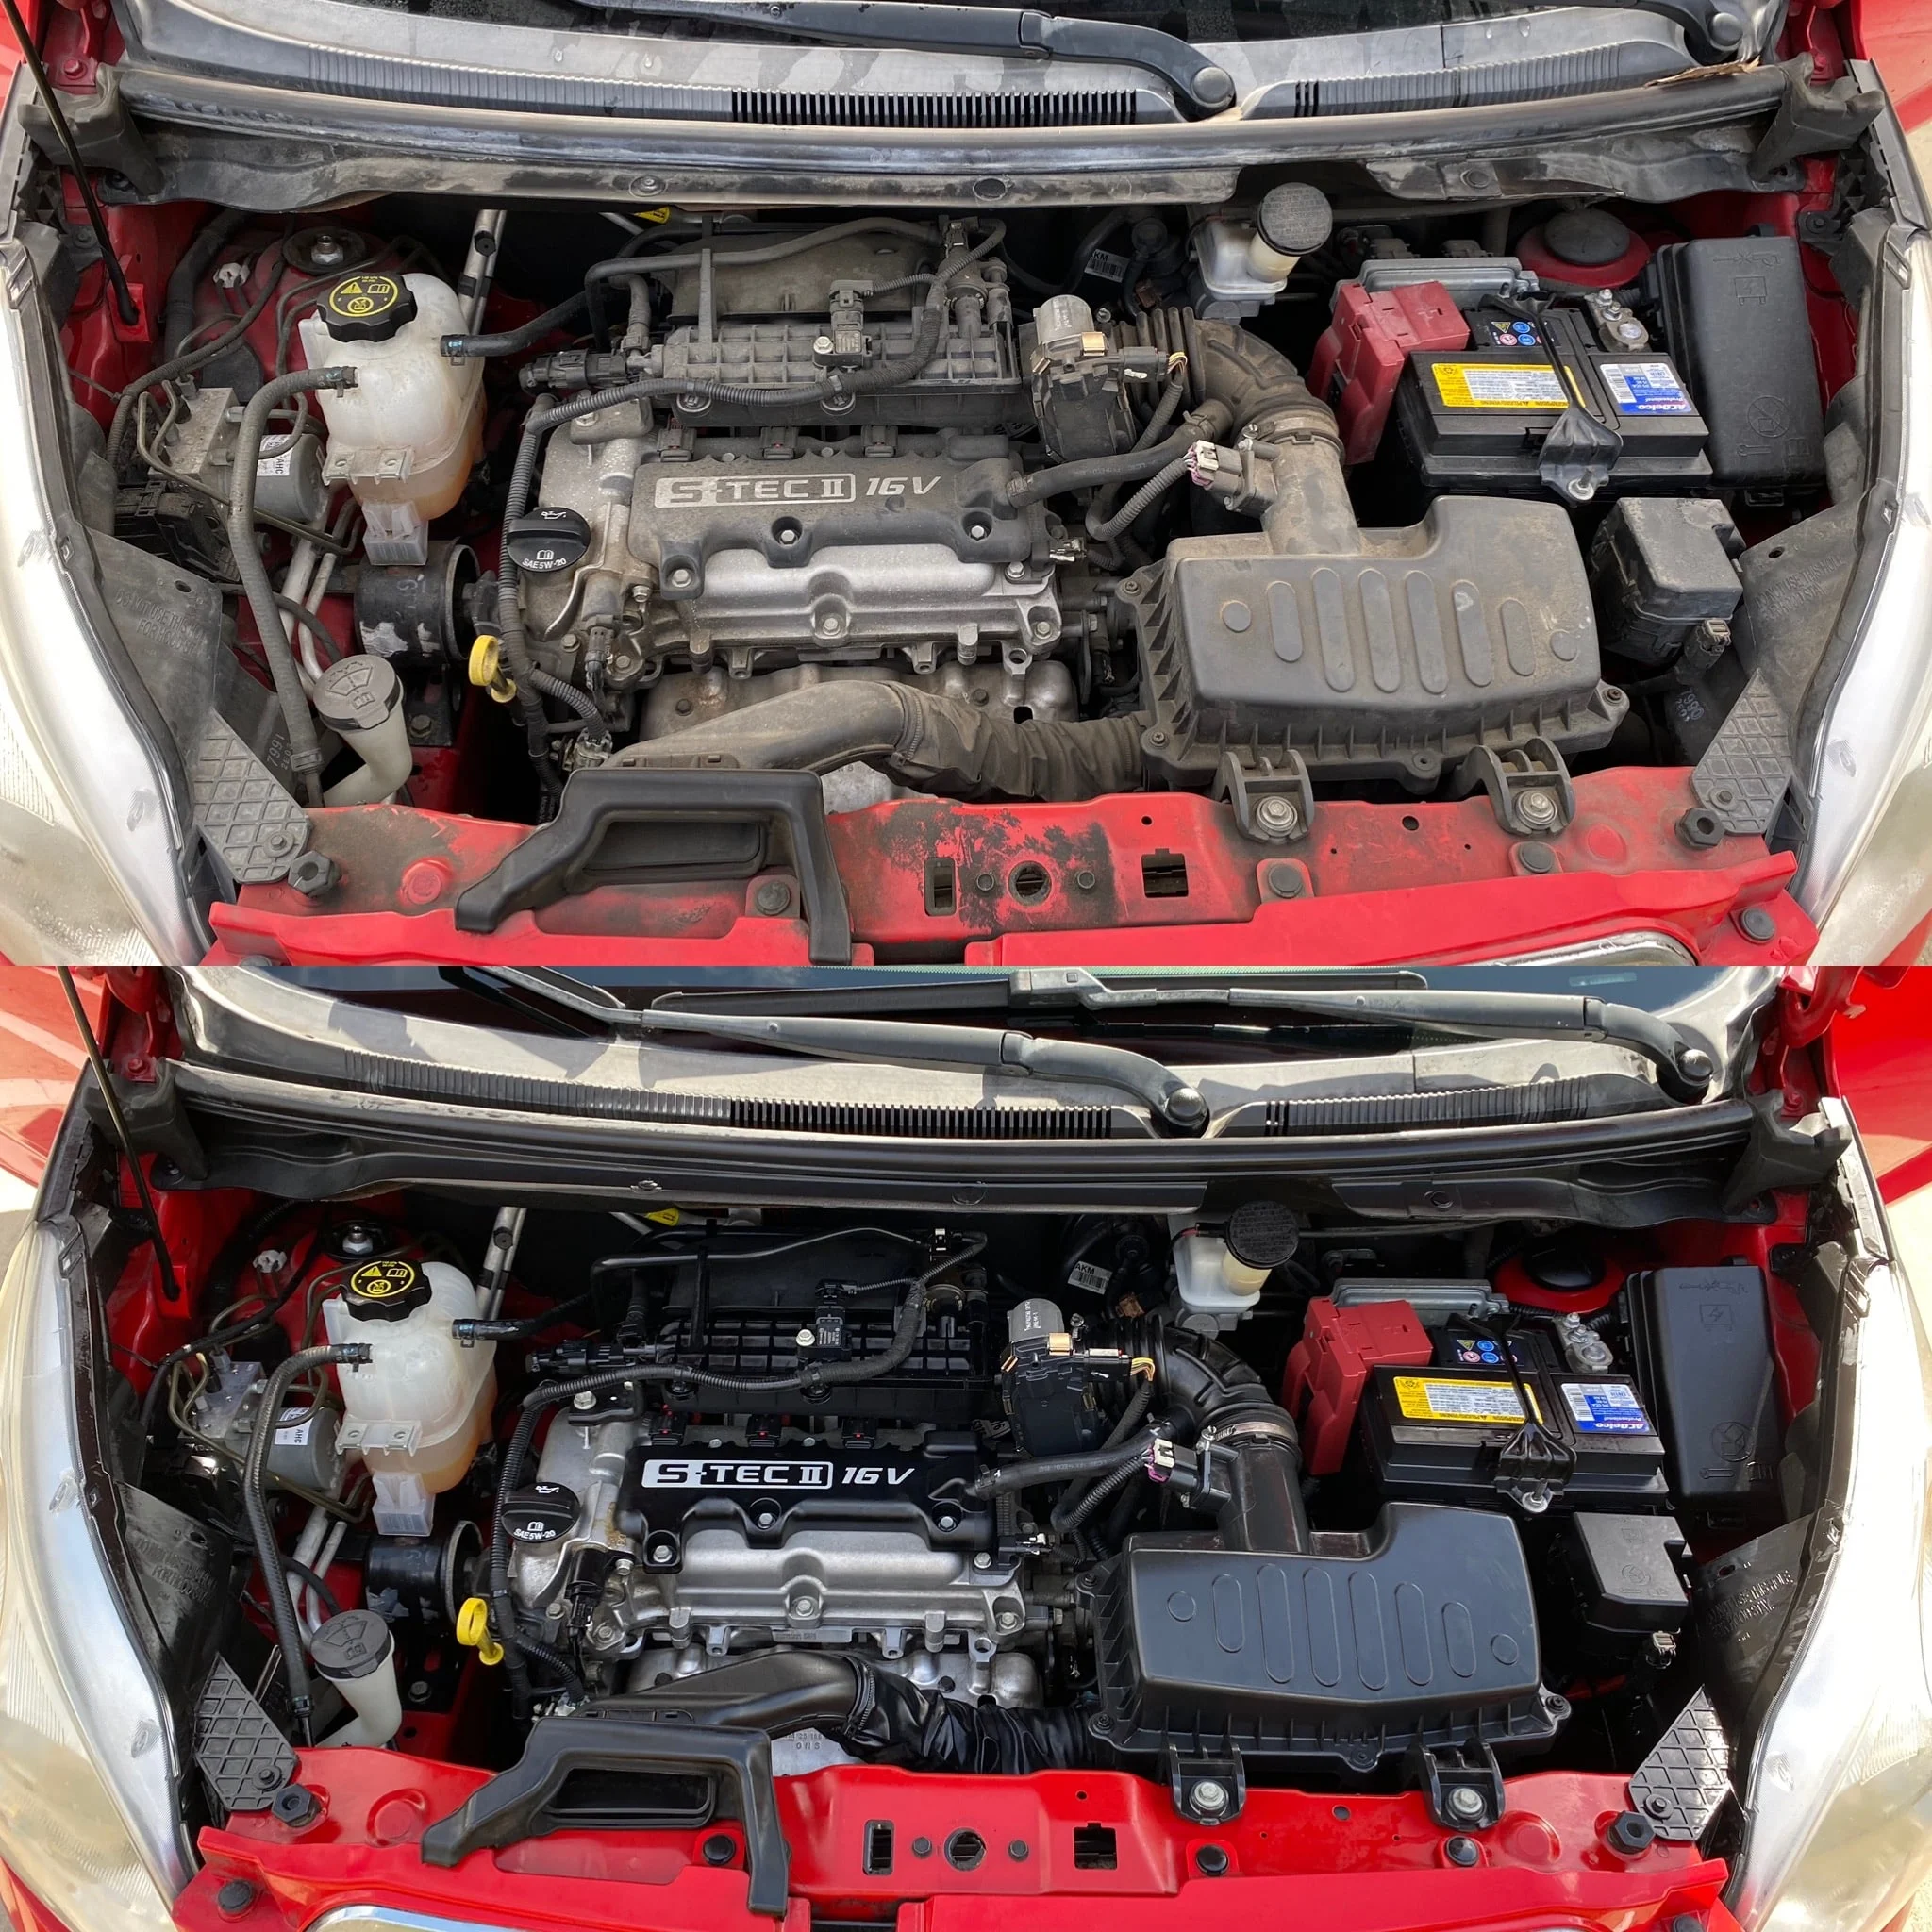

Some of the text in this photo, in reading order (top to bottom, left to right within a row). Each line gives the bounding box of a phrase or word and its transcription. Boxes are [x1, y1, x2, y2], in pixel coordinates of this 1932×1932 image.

[1637, 403, 1687, 411] ACDelco
[275, 458, 285, 475] AHC
[1074, 1263, 1095, 1275] AKM
[293, 1428, 305, 1444] AHC
[841, 1467, 916, 1485] 16V
